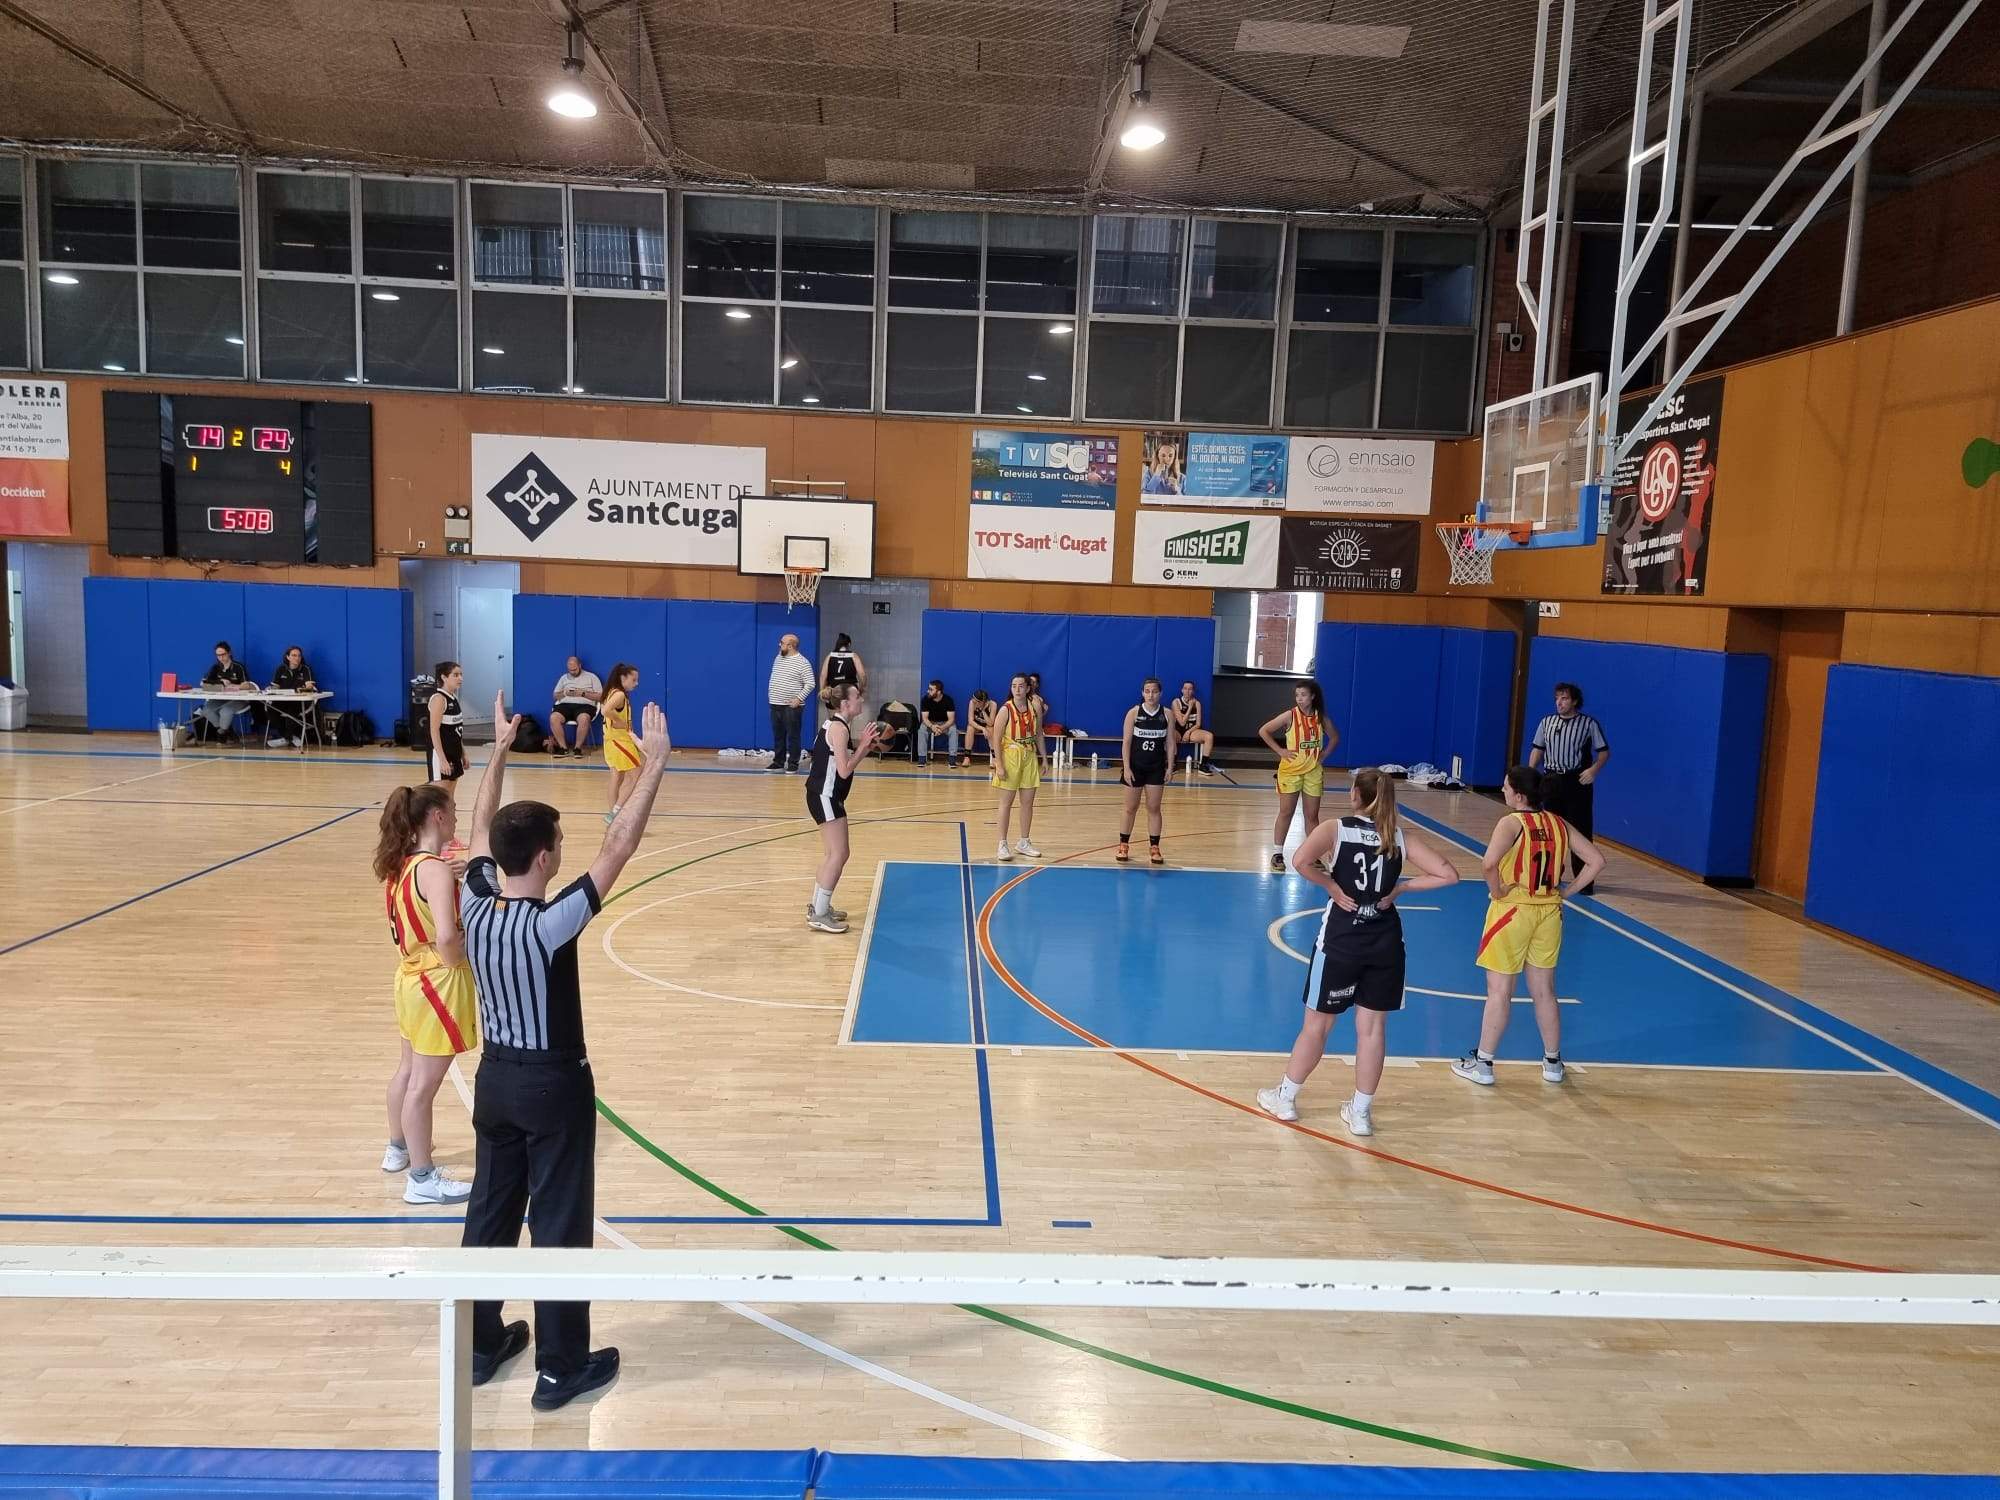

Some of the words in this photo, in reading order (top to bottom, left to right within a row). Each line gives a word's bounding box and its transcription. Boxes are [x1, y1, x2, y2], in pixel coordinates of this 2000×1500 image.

[1640, 424, 1669, 442] sportiva
[1670, 419, 1687, 433] Sant
[1688, 414, 1711, 431] Cugat
[201, 428, 221, 447] 14
[232, 430, 243, 447] 2
[260, 431, 287, 449] 24
[281, 460, 291, 475] 4
[1349, 451, 1415, 468] ennsaio
[998, 469, 1038, 479] Televisió
[1040, 471, 1060, 480] Sant
[1063, 472, 1089, 482] Cugat
[1, 486, 46, 499] Occident
[588, 478, 723, 500] AJUNTAMENT
[729, 484, 752, 501] DE
[1314, 485, 1353, 494] FORMACIÓN
[1360, 486, 1404, 494] DESARROLLO
[224, 510, 270, 531] 5:08
[587, 499, 738, 535] SantCuga
[975, 531, 1012, 548] TOT
[1013, 532, 1051, 550] Sant
[1060, 534, 1107, 555] Cugat
[1167, 530, 1241, 557] FINISHER
[1177, 569, 1198, 577] KERN
[837, 660, 844, 673] 7
[1142, 740, 1155, 751] 63
[1353, 852, 1384, 892] 31
